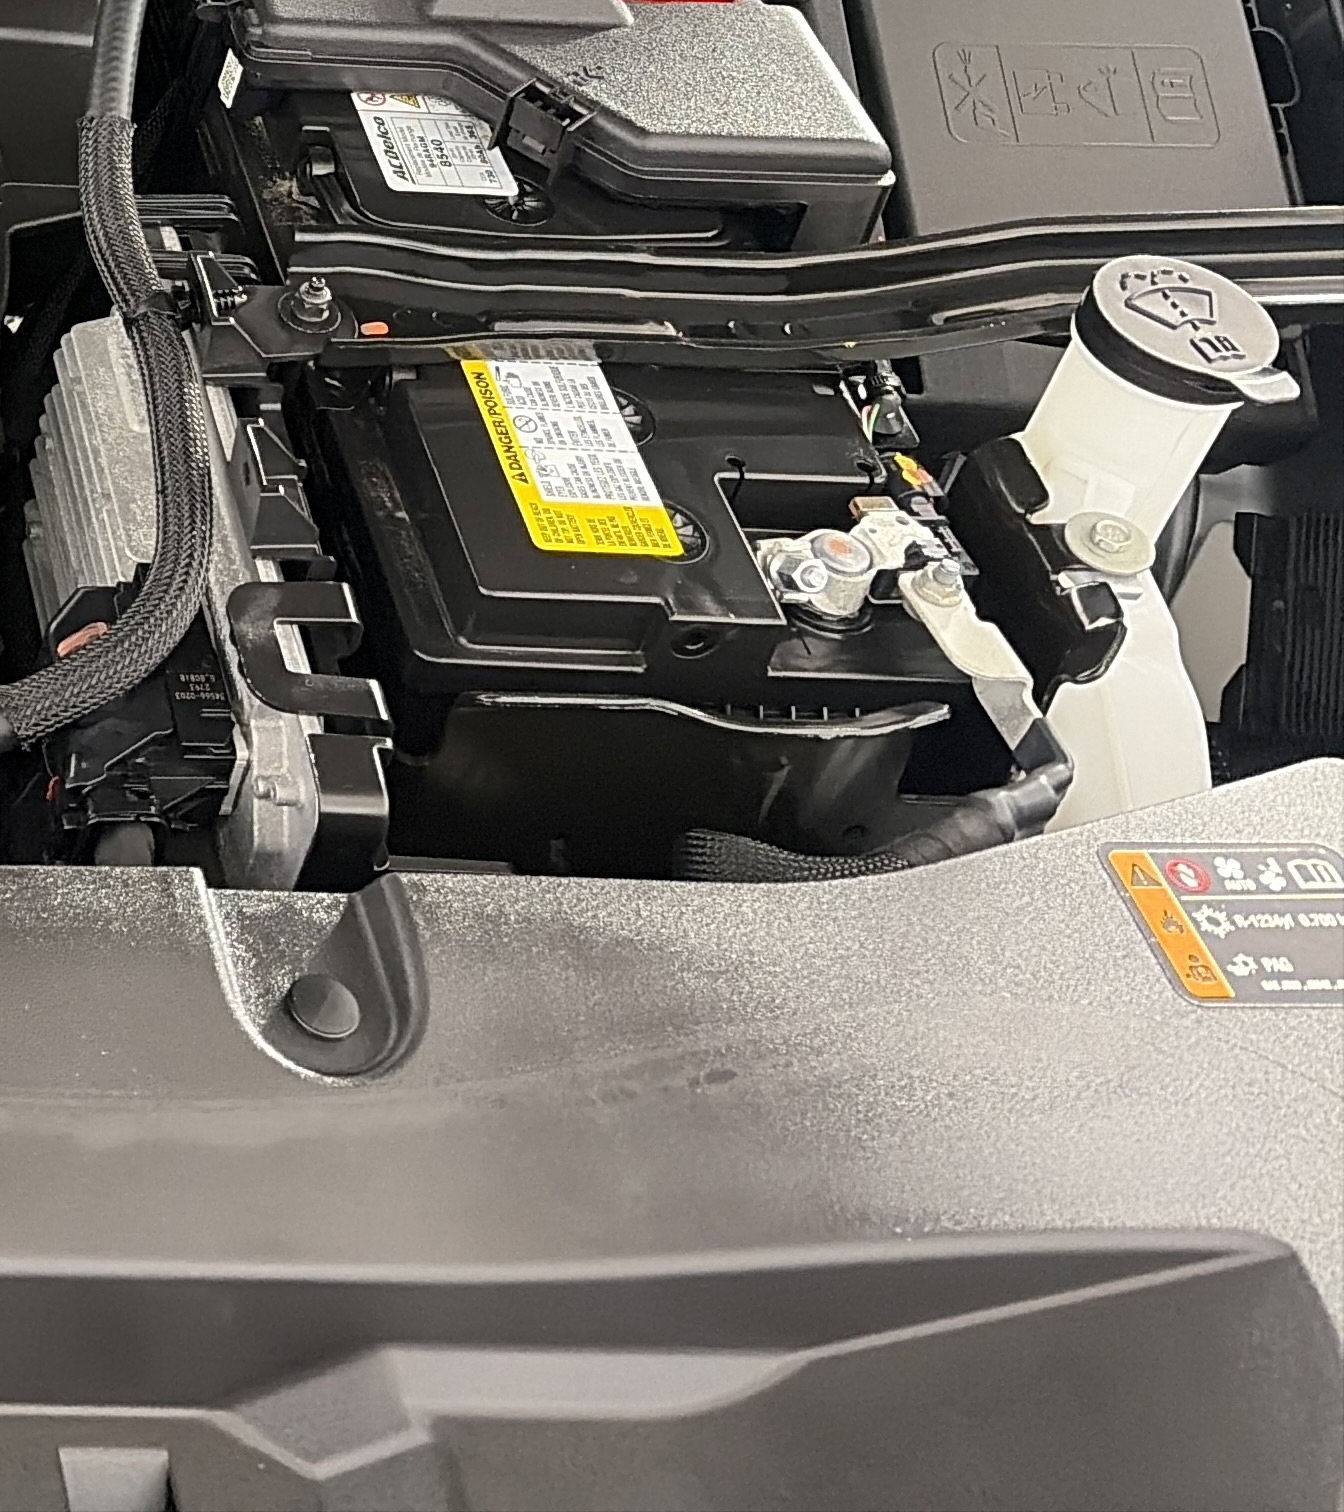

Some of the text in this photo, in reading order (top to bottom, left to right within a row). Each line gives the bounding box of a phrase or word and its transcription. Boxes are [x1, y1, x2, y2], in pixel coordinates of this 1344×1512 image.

[373, 116, 410, 182] ACDelco
[430, 139, 452, 168] 8540
[471, 372, 524, 471] DANGER/POISON
